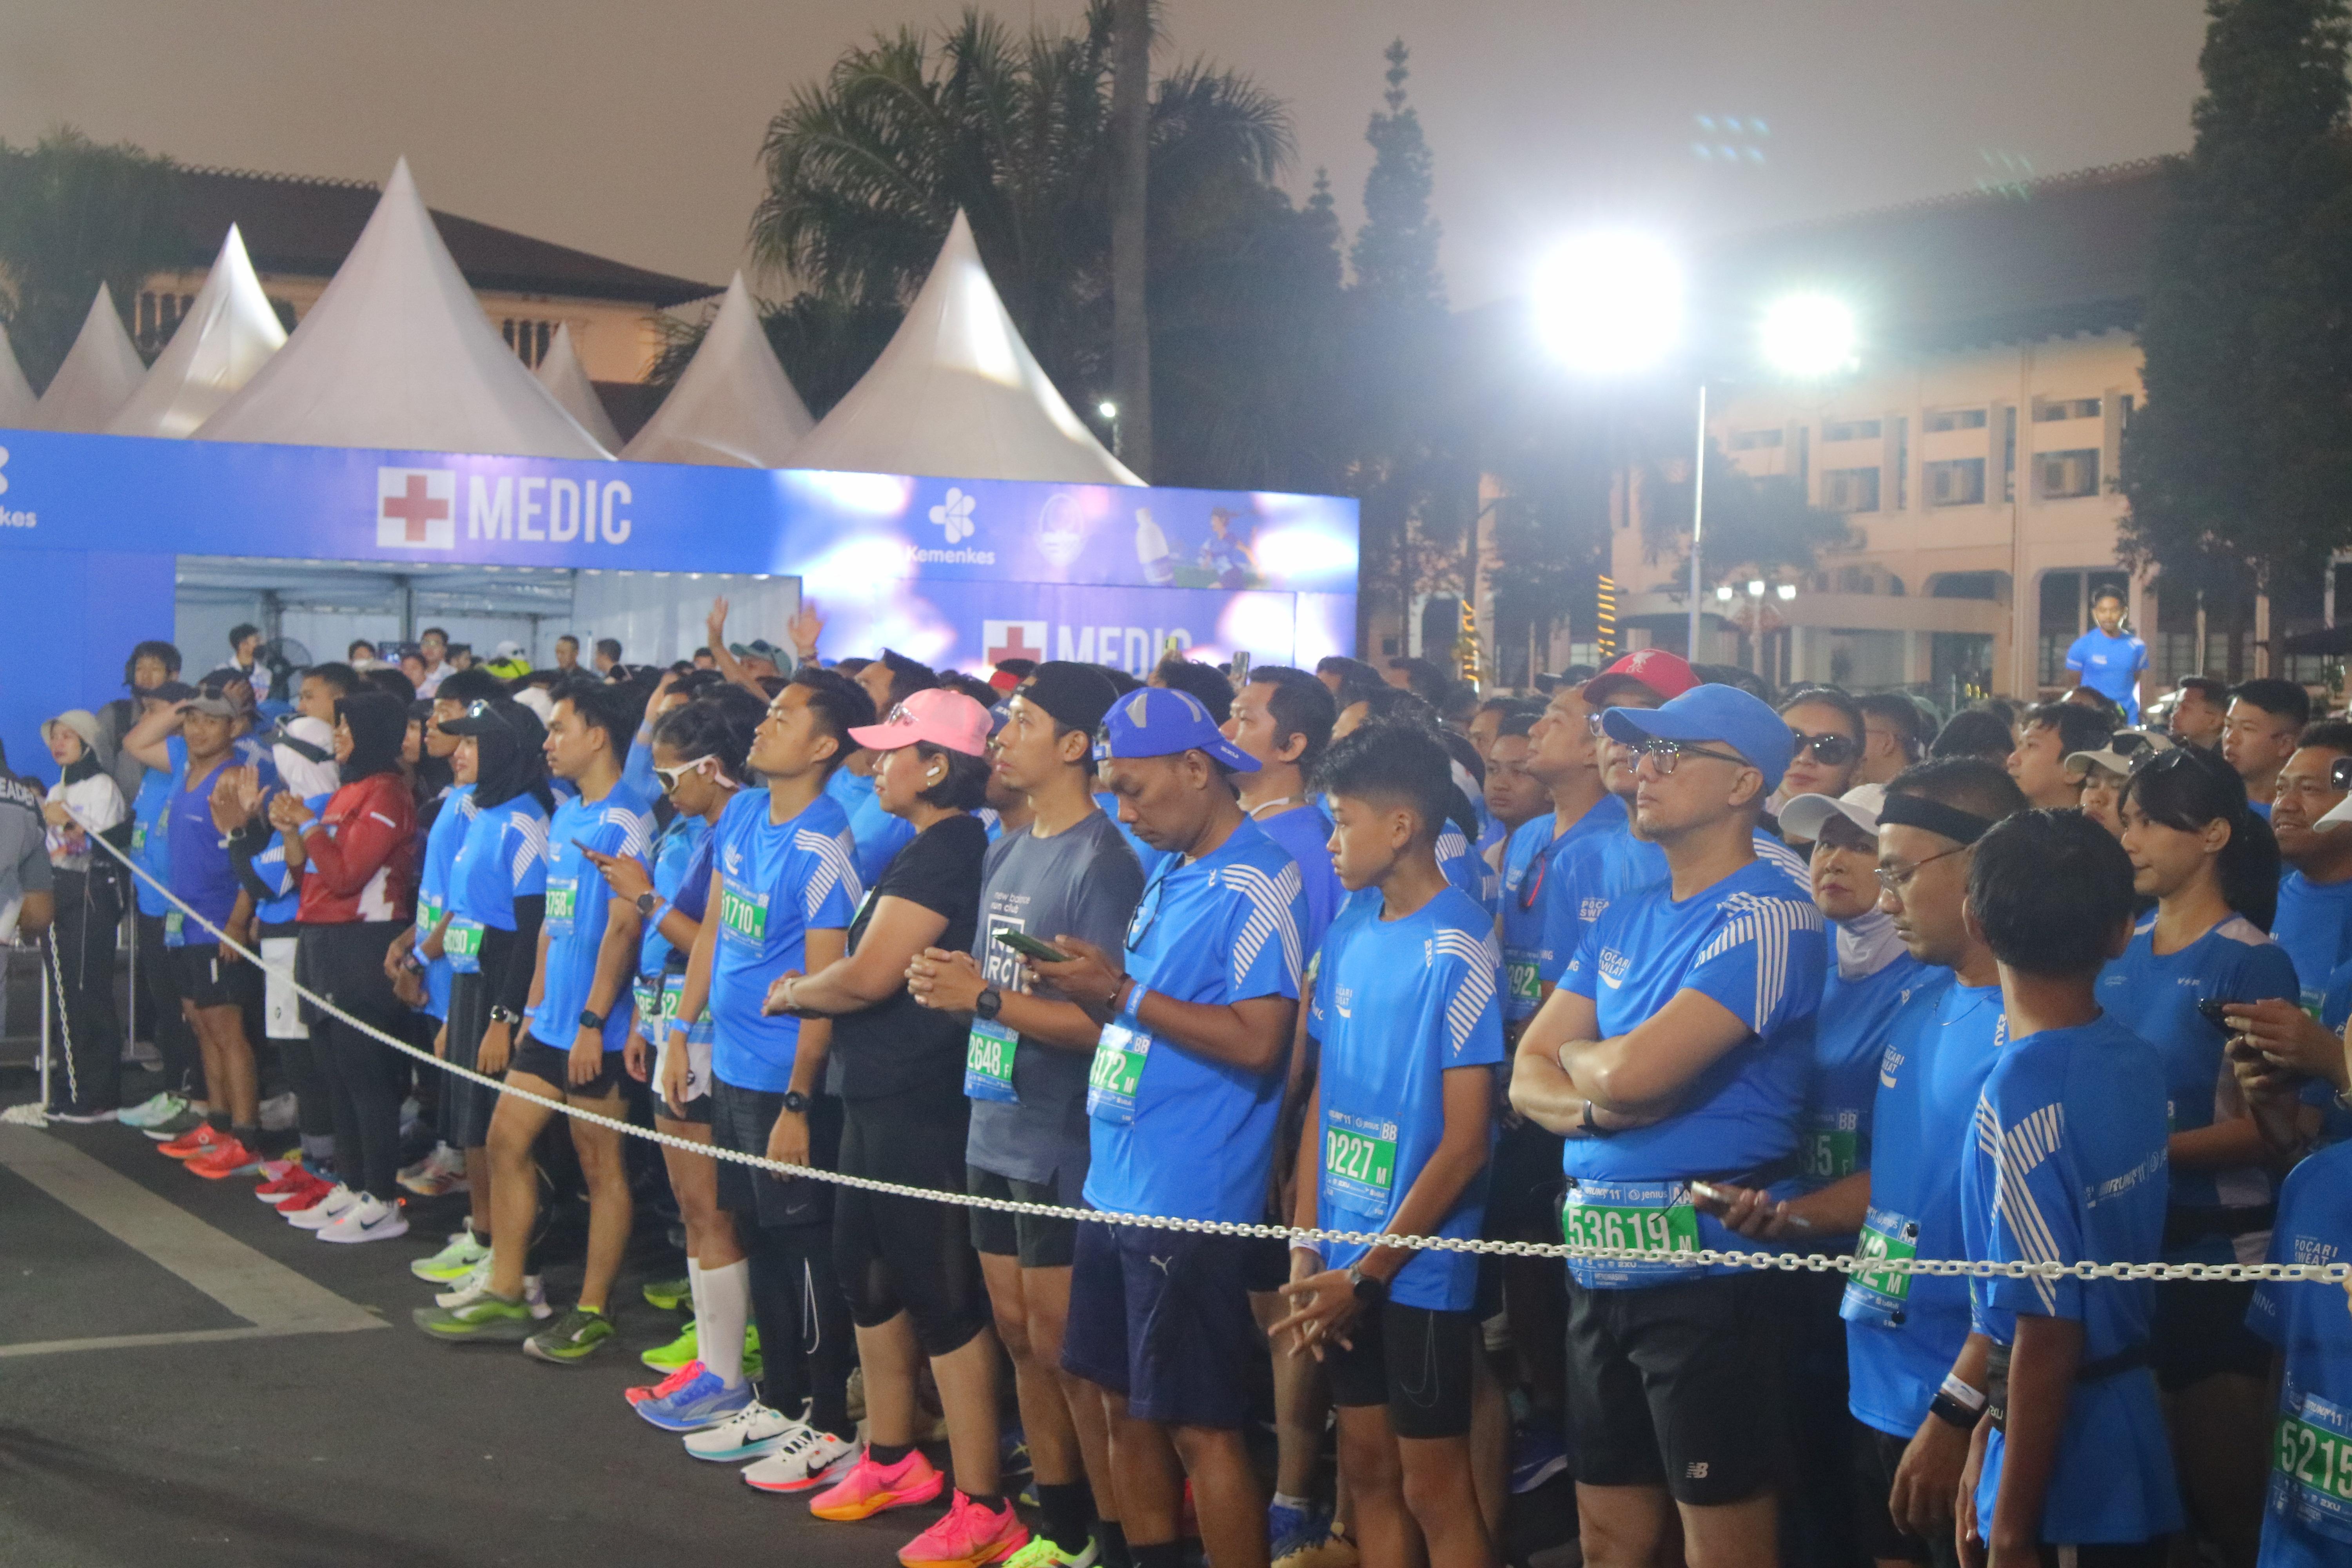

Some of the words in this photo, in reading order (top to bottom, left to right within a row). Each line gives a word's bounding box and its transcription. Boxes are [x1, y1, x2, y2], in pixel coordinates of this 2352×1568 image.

[469, 476, 632, 545] MEDIC
[906, 545, 996, 565] Kemenkes
[1134, 1036, 1150, 1054] BB
[968, 1034, 1002, 1076] 2648
[1004, 1063, 1010, 1078] F
[1123, 1076, 1135, 1094] M
[1839, 1112, 1857, 1130] BB
[1381, 1123, 1398, 1141] BB
[1376, 1167, 1387, 1185] M
[1641, 1190, 1668, 1201] jenius
[1568, 1208, 1671, 1253] 53619
[1679, 1235, 1692, 1252] M
[2295, 1239, 2338, 1258] POCARI
[1886, 1273, 1902, 1294] M
[2282, 1420, 2352, 1498] 5215
[2320, 1499, 2341, 1512] 2XU
